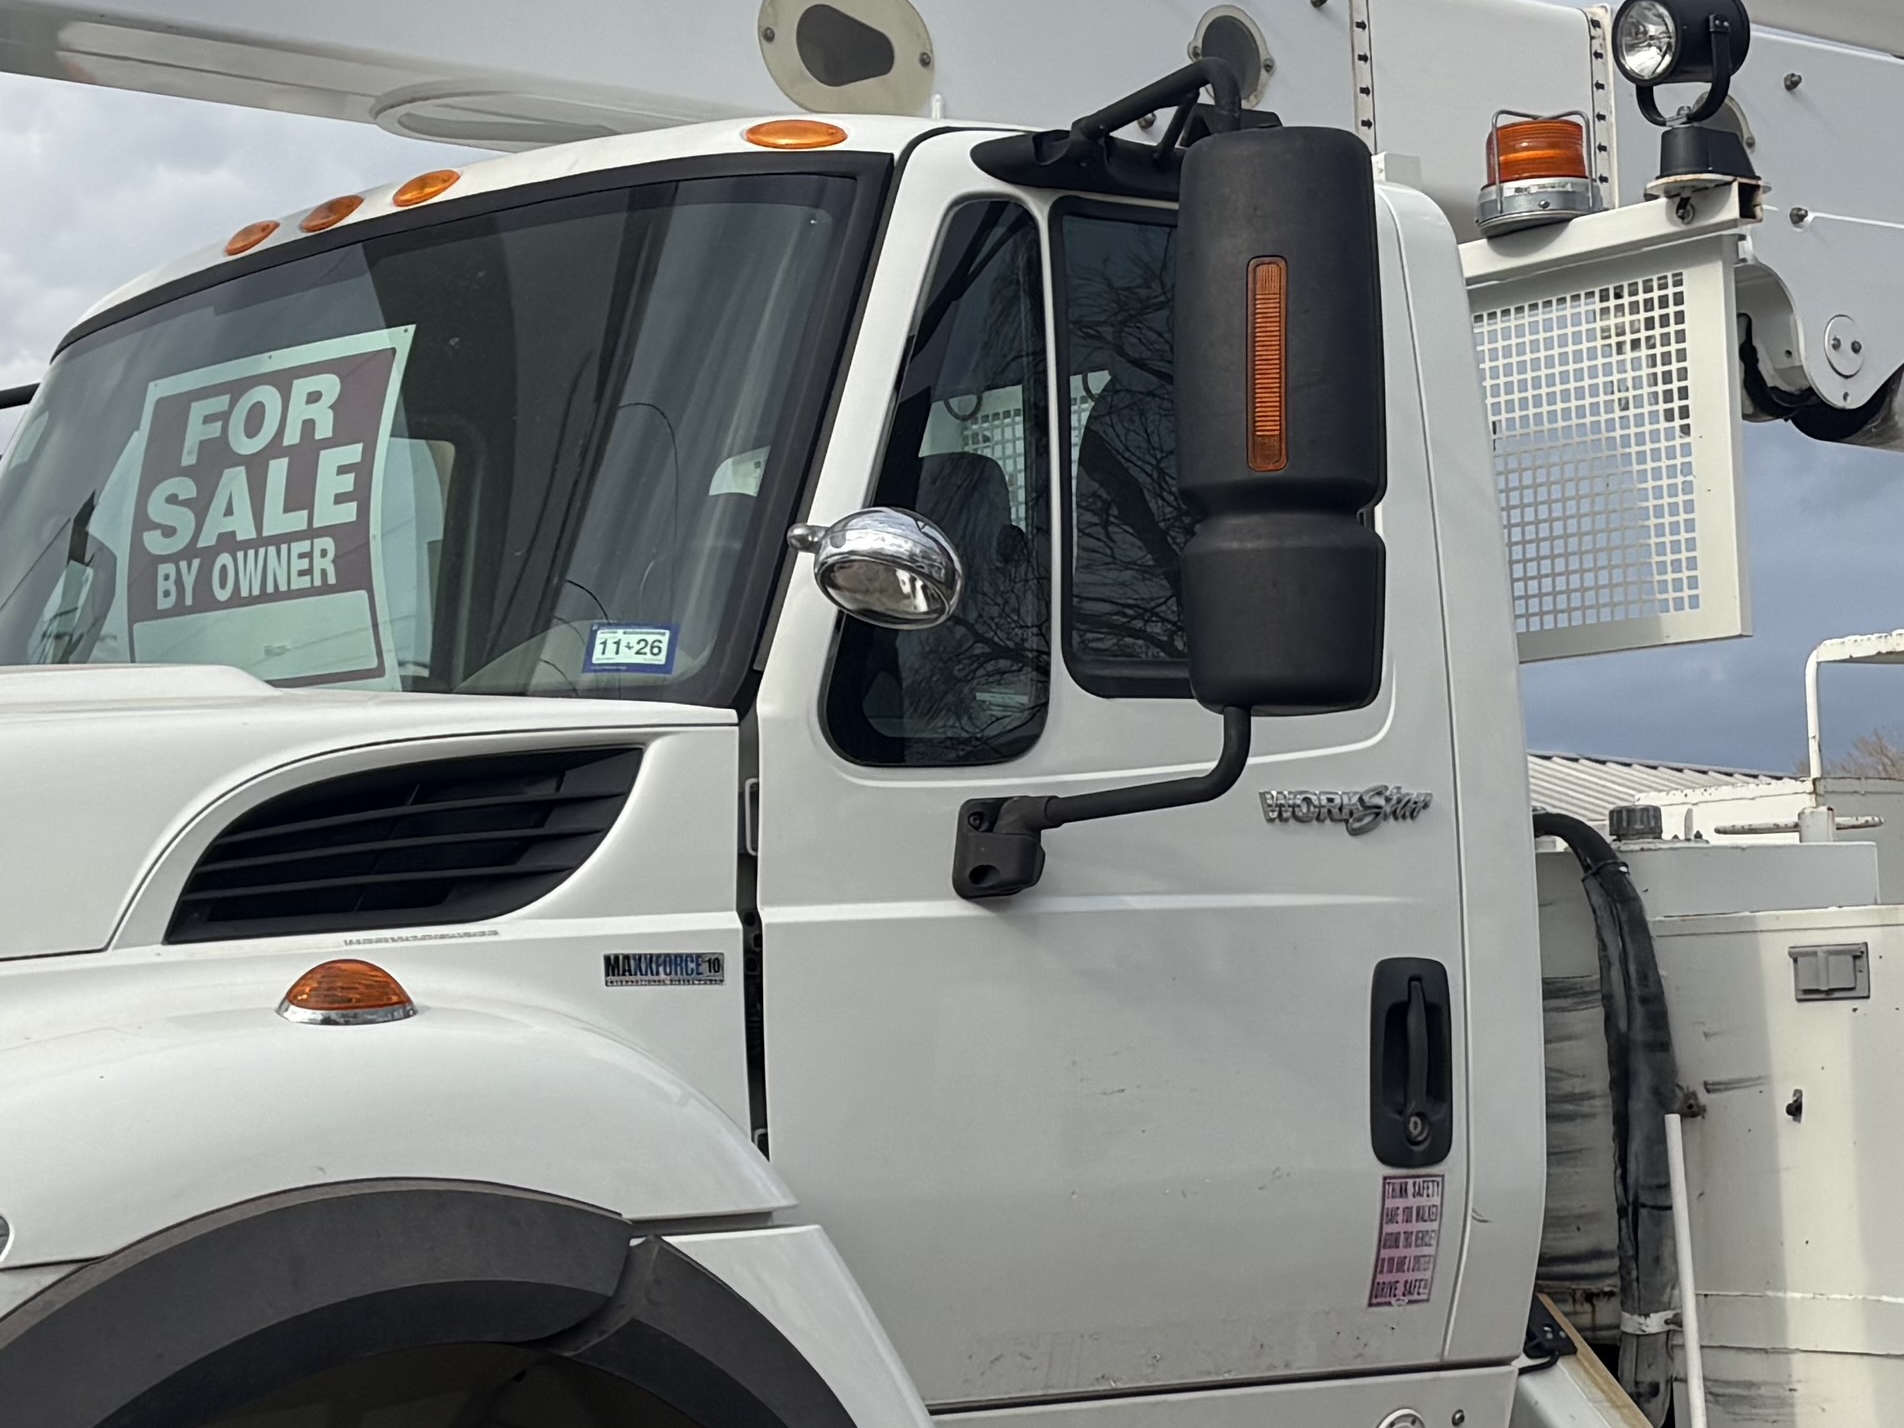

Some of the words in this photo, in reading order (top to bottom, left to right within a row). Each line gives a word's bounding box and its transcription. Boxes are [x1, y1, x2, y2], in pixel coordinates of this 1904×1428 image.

[180, 372, 342, 467] FOR
[142, 442, 364, 557] SALE
[156, 562, 198, 611] BY
[210, 536, 337, 602] OWNER
[605, 953, 704, 977] MAXXFORCE
[706, 957, 721, 974] 10
[1386, 1181, 1409, 1199] THINK
[1412, 1179, 1440, 1198] SAFETY
[1385, 1206, 1399, 1224] HAVE
[1401, 1205, 1413, 1224] YOU
[1415, 1204, 1438, 1223] WALKED
[1374, 1281, 1399, 1299] DRIVE
